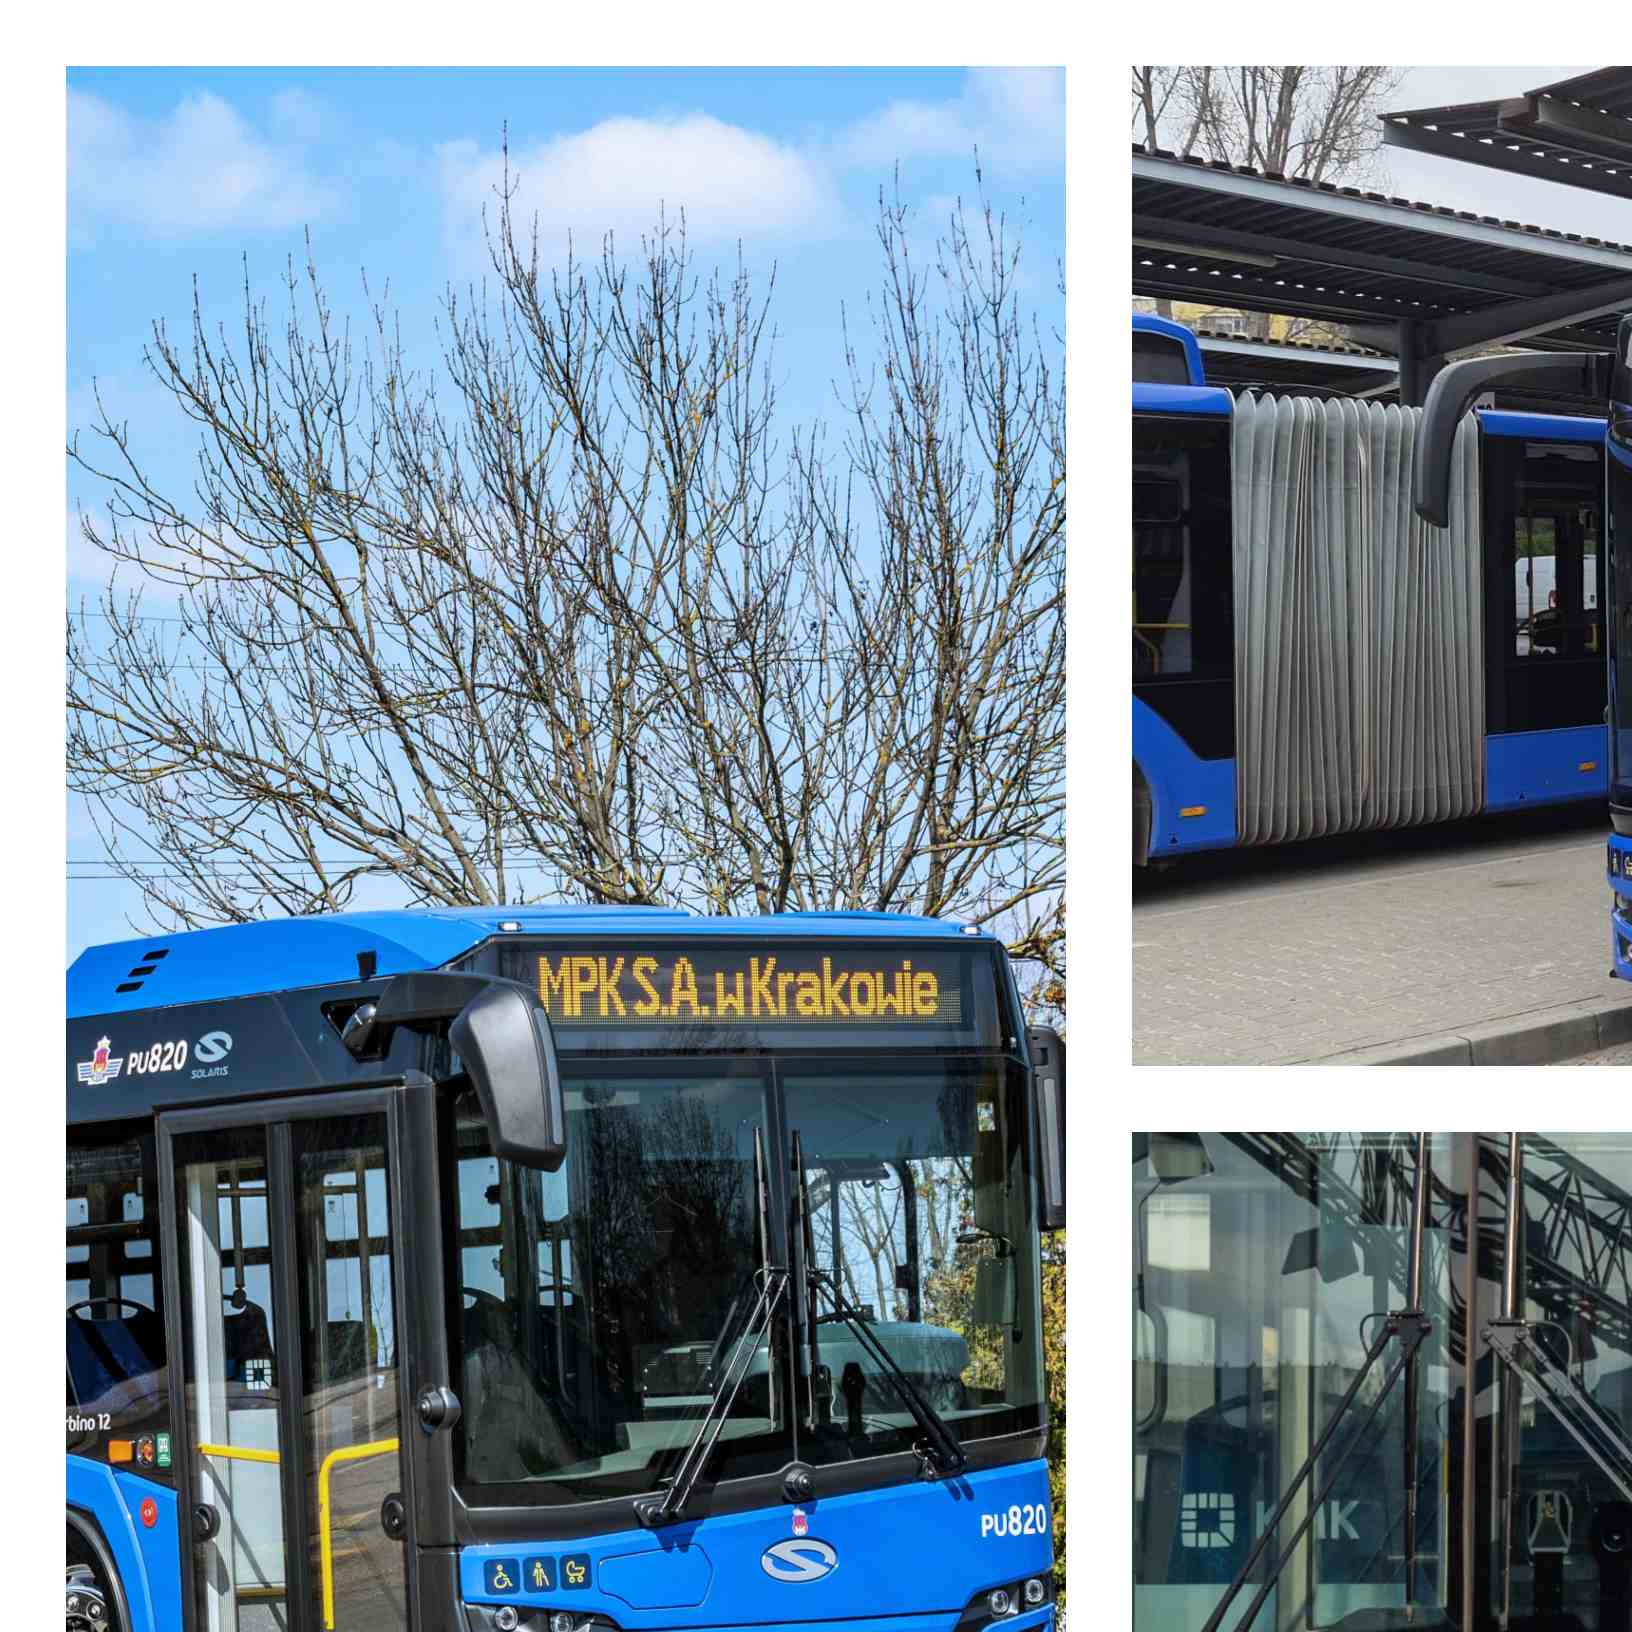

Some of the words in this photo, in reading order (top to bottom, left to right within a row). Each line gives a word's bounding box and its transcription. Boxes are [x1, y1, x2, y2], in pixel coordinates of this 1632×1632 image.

[538, 956, 626, 1017] MPK
[631, 956, 711, 1017] S.A.
[749, 956, 940, 1017] Krakowie
[127, 1039, 189, 1075] PU820
[190, 1066, 229, 1080] SOLARIS
[97, 1413, 111, 1431] 12
[981, 1503, 1047, 1538] PU820
